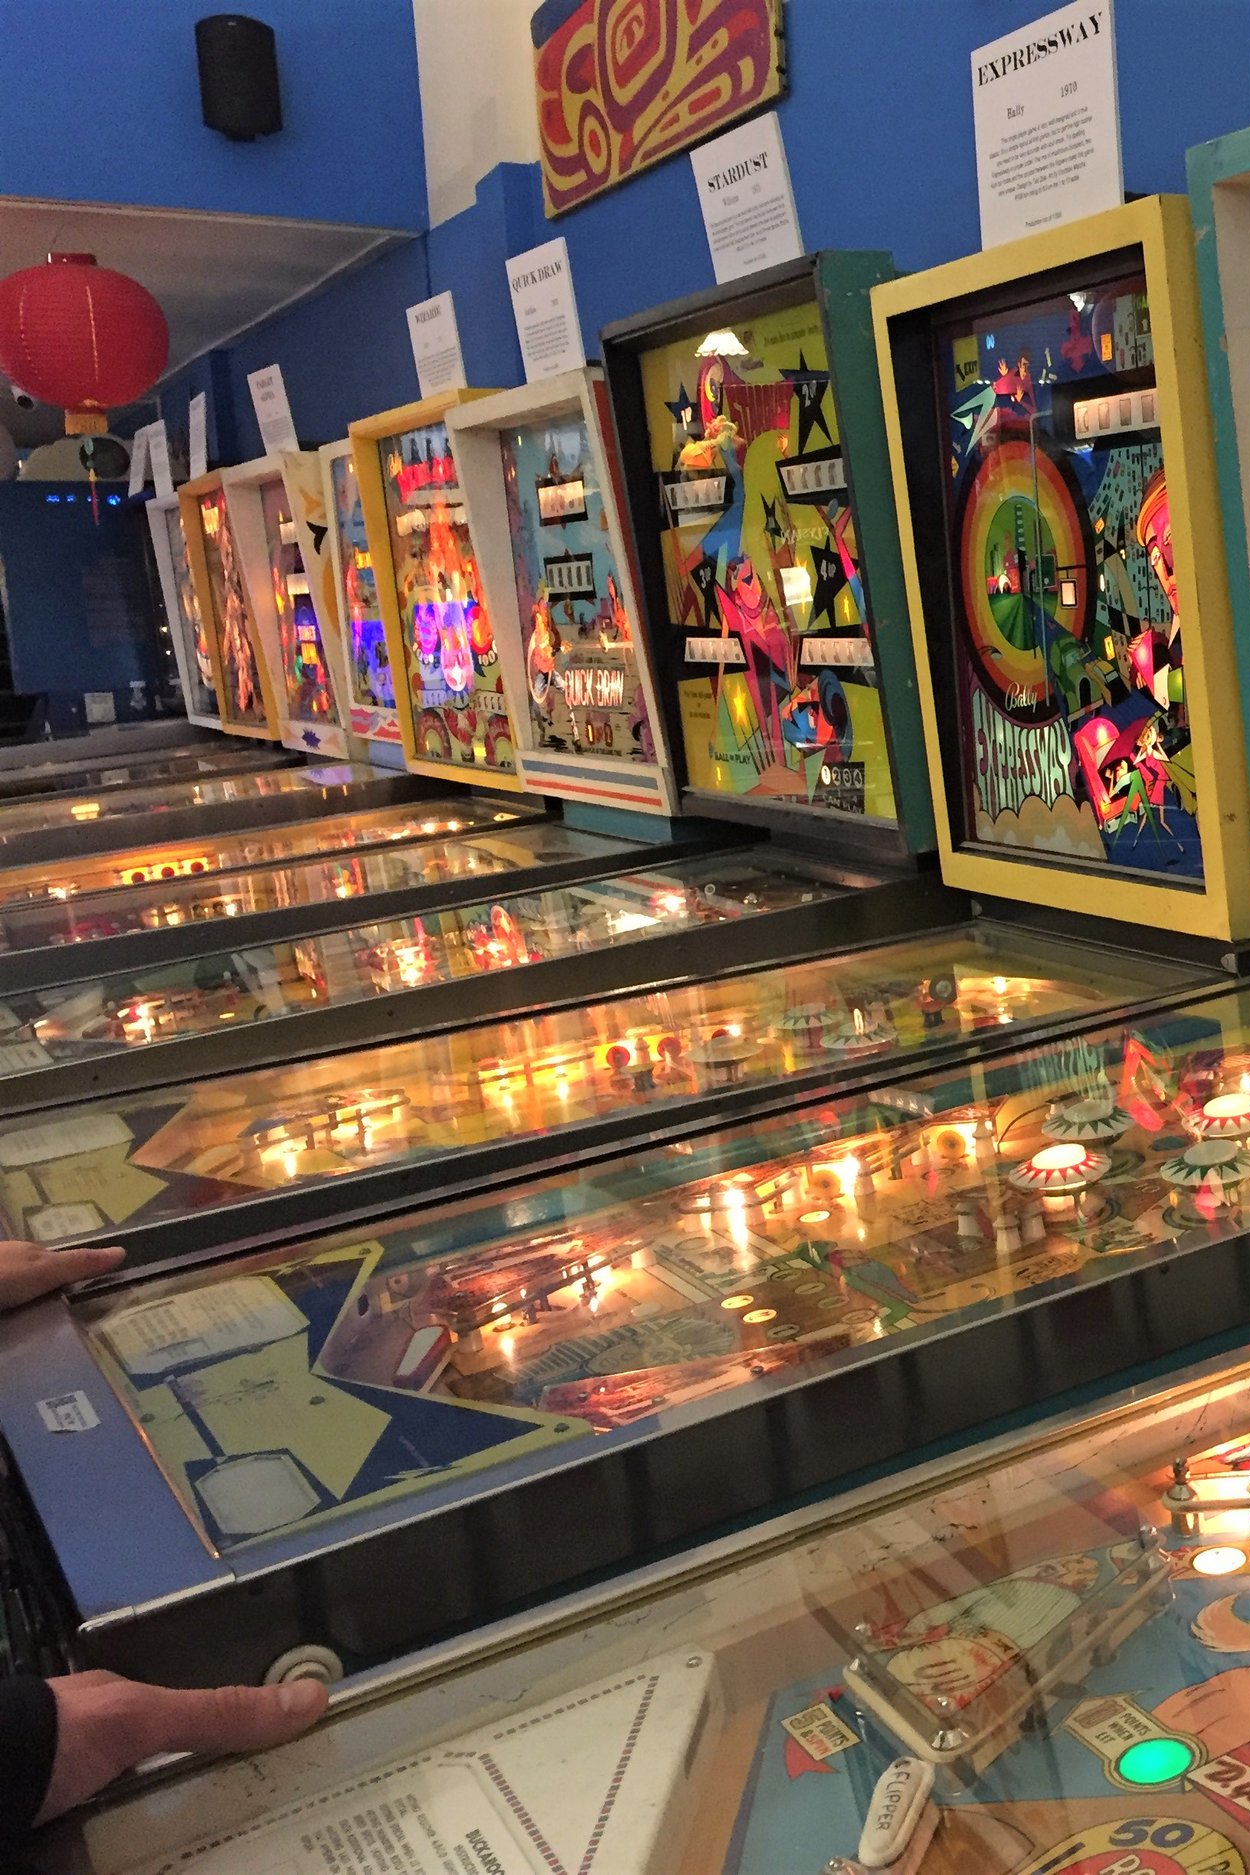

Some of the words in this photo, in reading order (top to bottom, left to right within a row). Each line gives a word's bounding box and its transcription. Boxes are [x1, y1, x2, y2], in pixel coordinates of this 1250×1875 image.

[977, 12, 1102, 86] EXPRESSWAY
[1060, 81, 1078, 98] 1970
[707, 152, 768, 193] STARDUST
[511, 270, 538, 293] QUICK
[538, 260, 563, 280] DRAW
[964, 361, 978, 376] EXIT
[563, 669, 595, 707] QUICK
[597, 669, 624, 707] DRAW
[1005, 681, 1038, 713] Bally
[714, 751, 730, 763] BALL
[734, 754, 751, 765] PLAY
[972, 688, 1076, 821] EXPRESSWAY
[789, 1707, 828, 1730] 5
[1107, 1721, 1134, 1742] WHEN
[1120, 1712, 1152, 1736] POINTS
[805, 1733, 833, 1755] SPIN
[815, 1720, 850, 1748] POINTS
[1094, 1731, 1116, 1744] LIT
[874, 1770, 912, 1831] FLIPPER
[1108, 1818, 1196, 1849] 50
